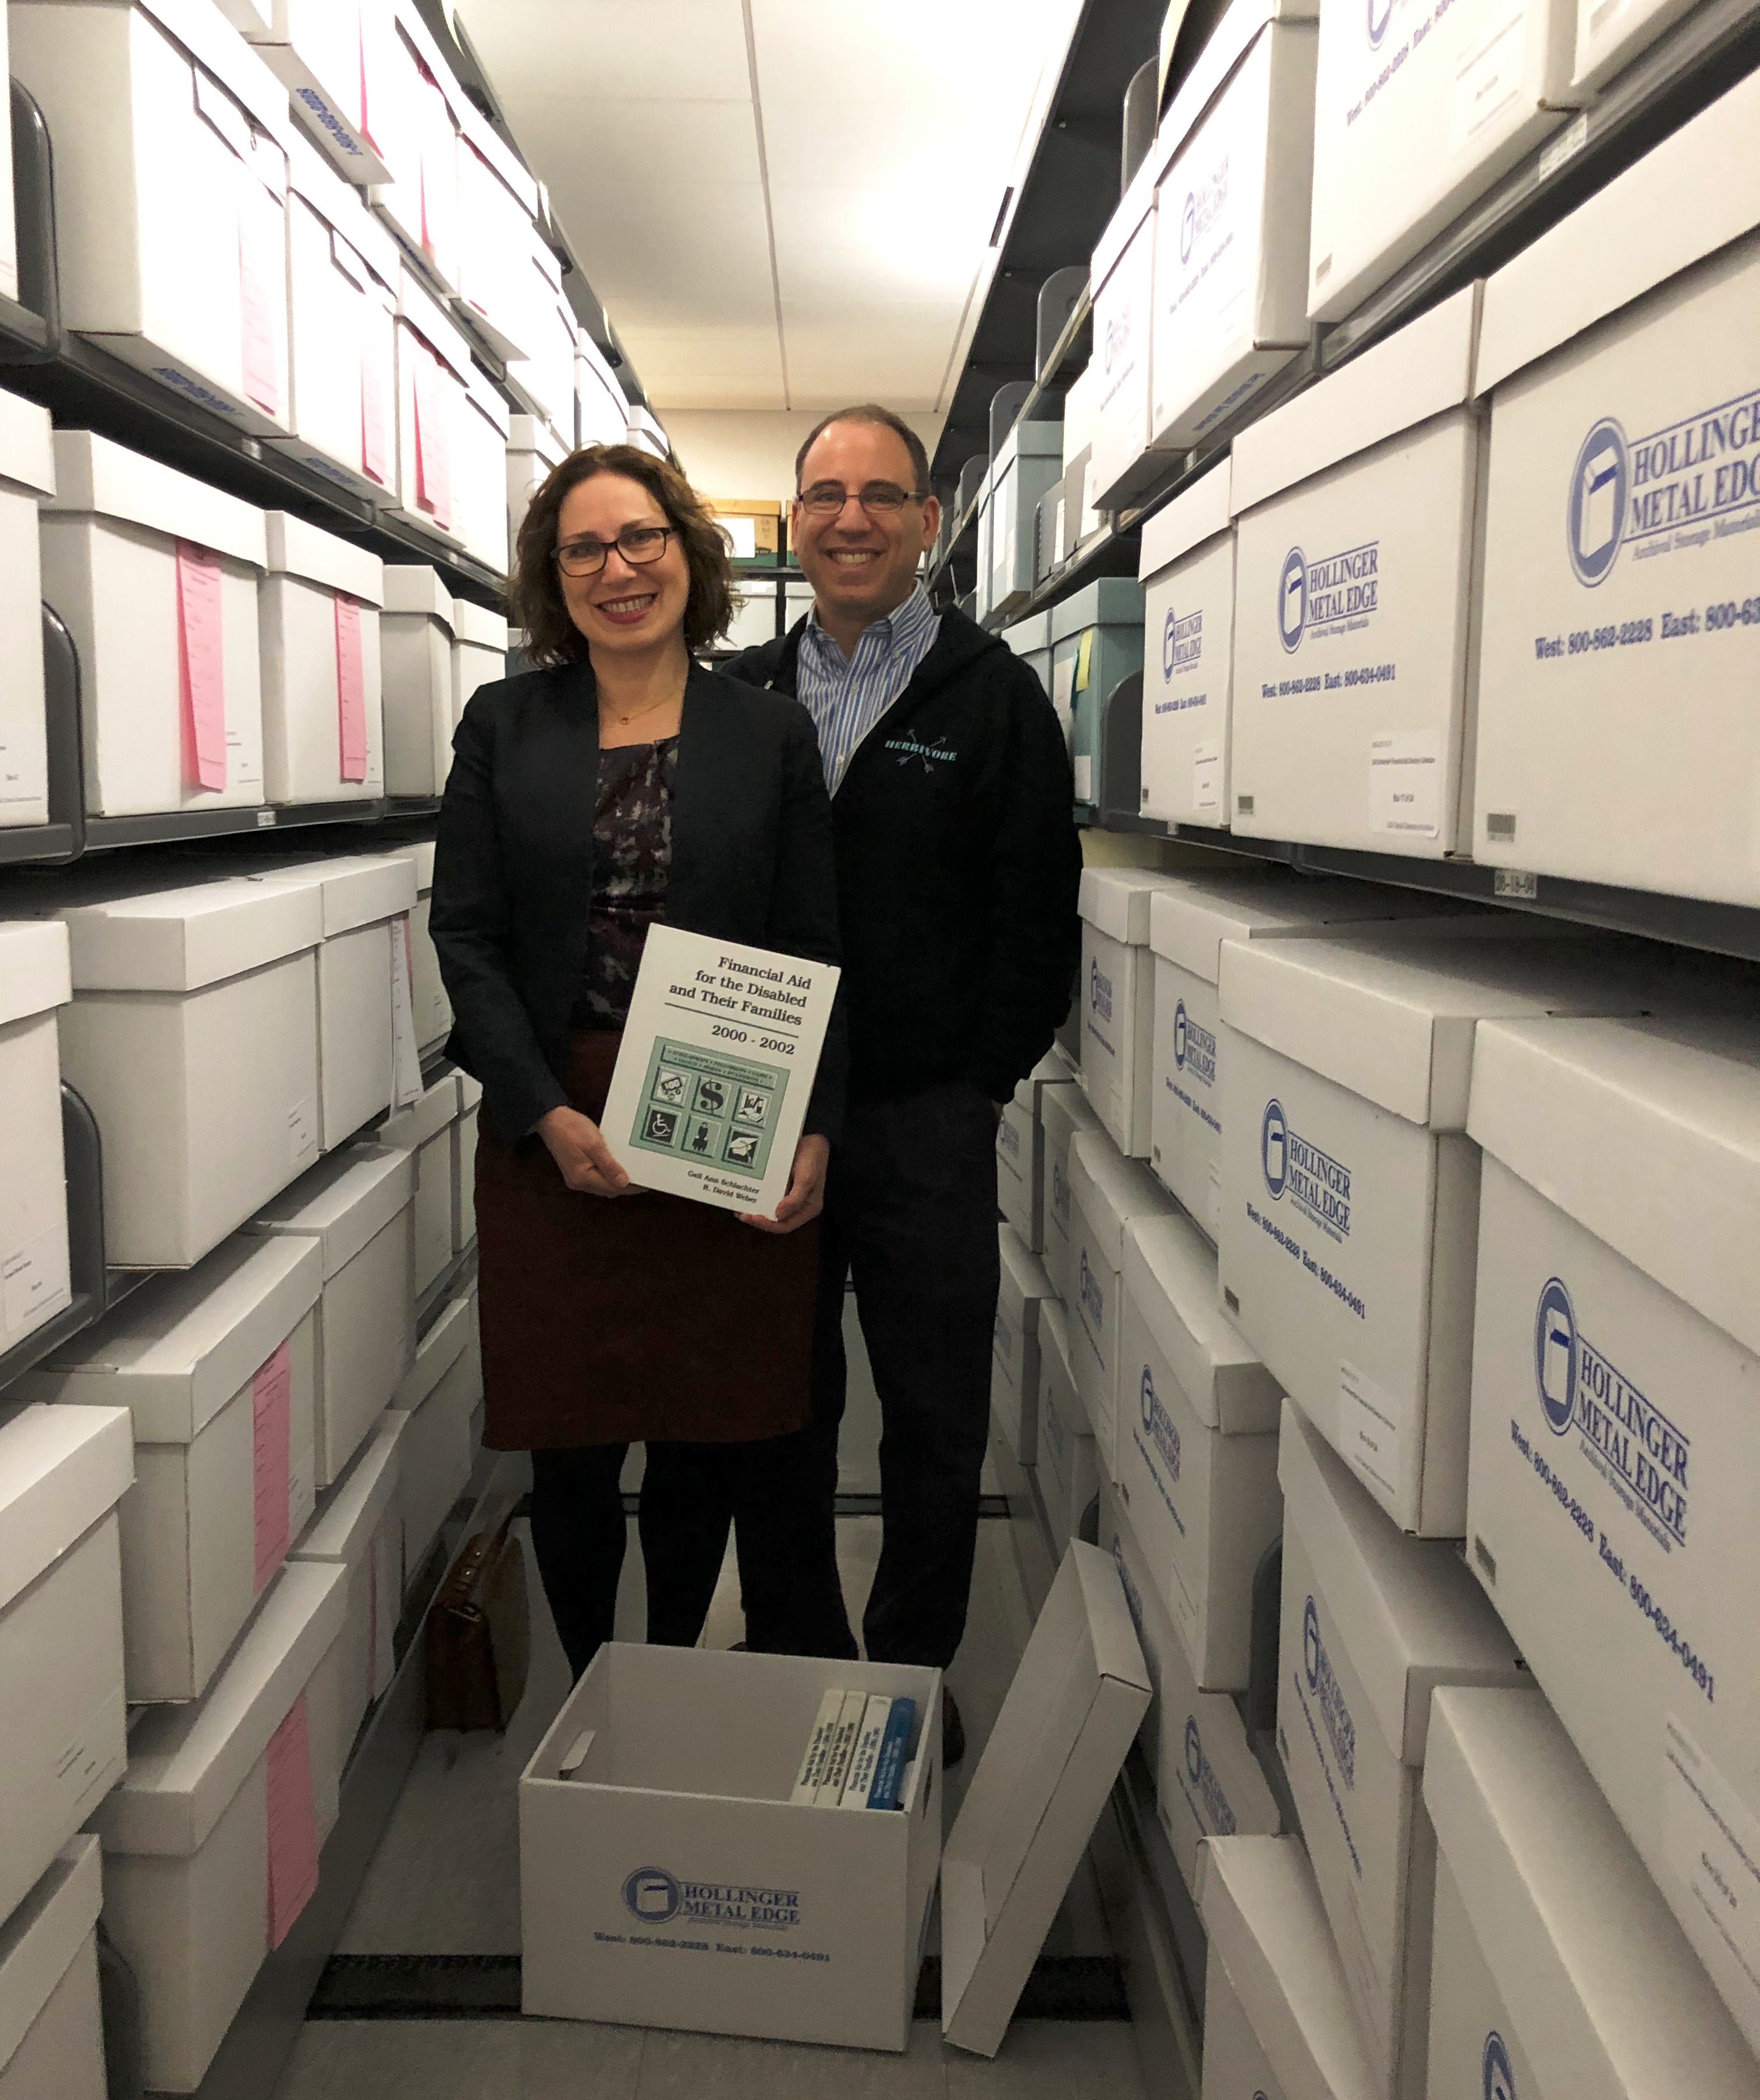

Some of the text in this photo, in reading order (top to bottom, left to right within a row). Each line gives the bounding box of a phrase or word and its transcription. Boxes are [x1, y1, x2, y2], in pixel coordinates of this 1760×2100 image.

[1630, 471, 1708, 534] METAL
[1310, 549, 1378, 594] HOLLINGER
[1309, 580, 1378, 621] METAL EDGE
[1535, 635, 1565, 660] West:
[1660, 608, 1700, 639] East:
[1324, 671, 1343, 690] East:
[884, 740, 957, 761] HERBIVORE
[695, 970, 807, 1008] for the Disabled
[718, 956, 812, 990] Financial Aid
[669, 985, 803, 1026] and Their Families
[711, 1025, 748, 1043] 2000
[759, 1037, 796, 1055] 2002
[704, 1175, 719, 1184] Ann
[1290, 1138, 1350, 1201] HOLLINGER
[702, 1184, 757, 1203] R. David Weber
[1289, 1165, 1350, 1231] METAL EDGE
[1580, 1348, 1689, 1491] HOLLINGER
[1578, 1392, 1687, 1537] METAL EDGE
[1511, 1418, 1533, 1463] West:
[1599, 1532, 1627, 1586] East:
[684, 1901, 800, 1923] METAL EDGE
[685, 1885, 798, 1907] HOLLINGER
[593, 1931, 626, 1942] West:
[716, 1943, 746, 1955] East:
